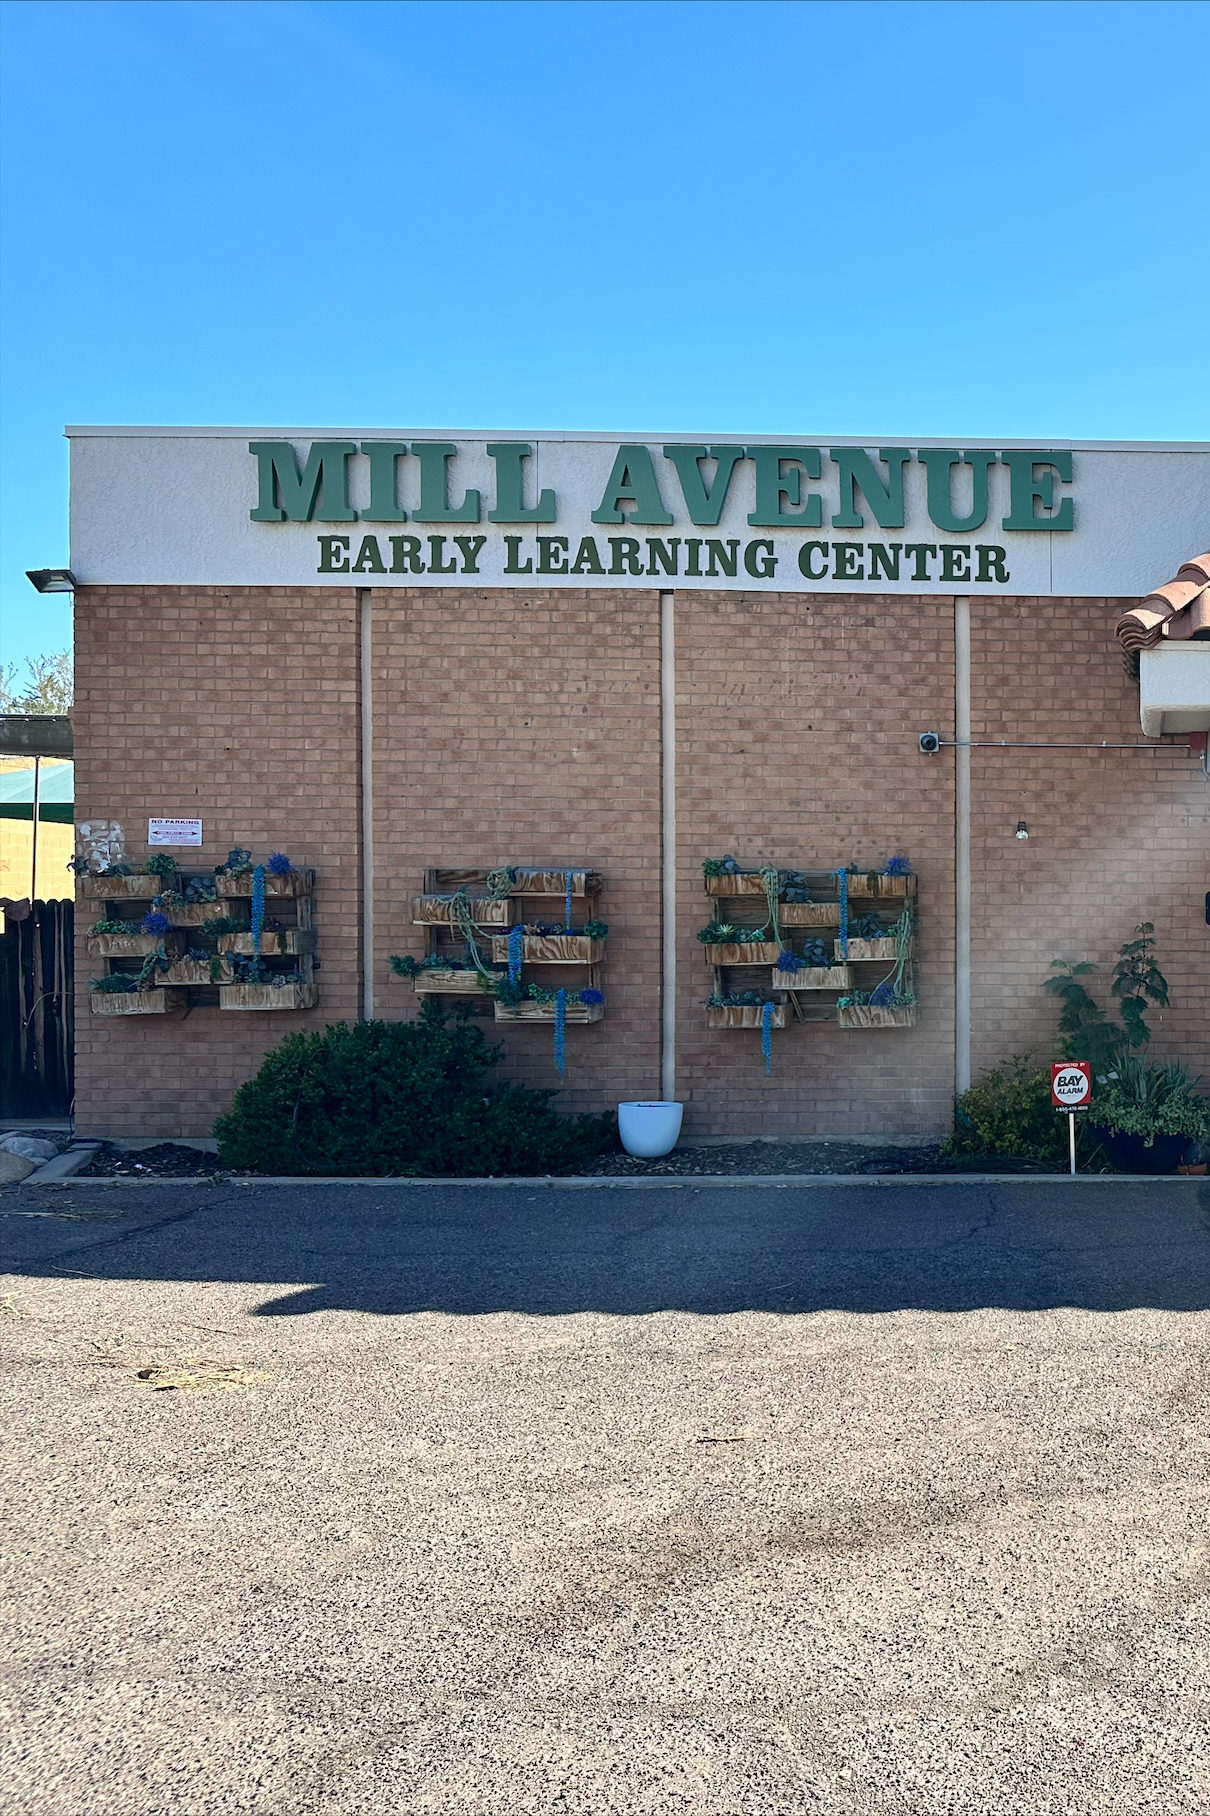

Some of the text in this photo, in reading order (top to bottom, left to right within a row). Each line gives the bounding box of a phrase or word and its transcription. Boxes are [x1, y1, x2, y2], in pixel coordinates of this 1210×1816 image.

[249, 441, 1073, 532] MILL AVENUE
[317, 535, 1011, 583] EARLY LEARNING CENTER
[1057, 1075, 1083, 1087] BAY
[1057, 1087, 1083, 1095] ALARM
